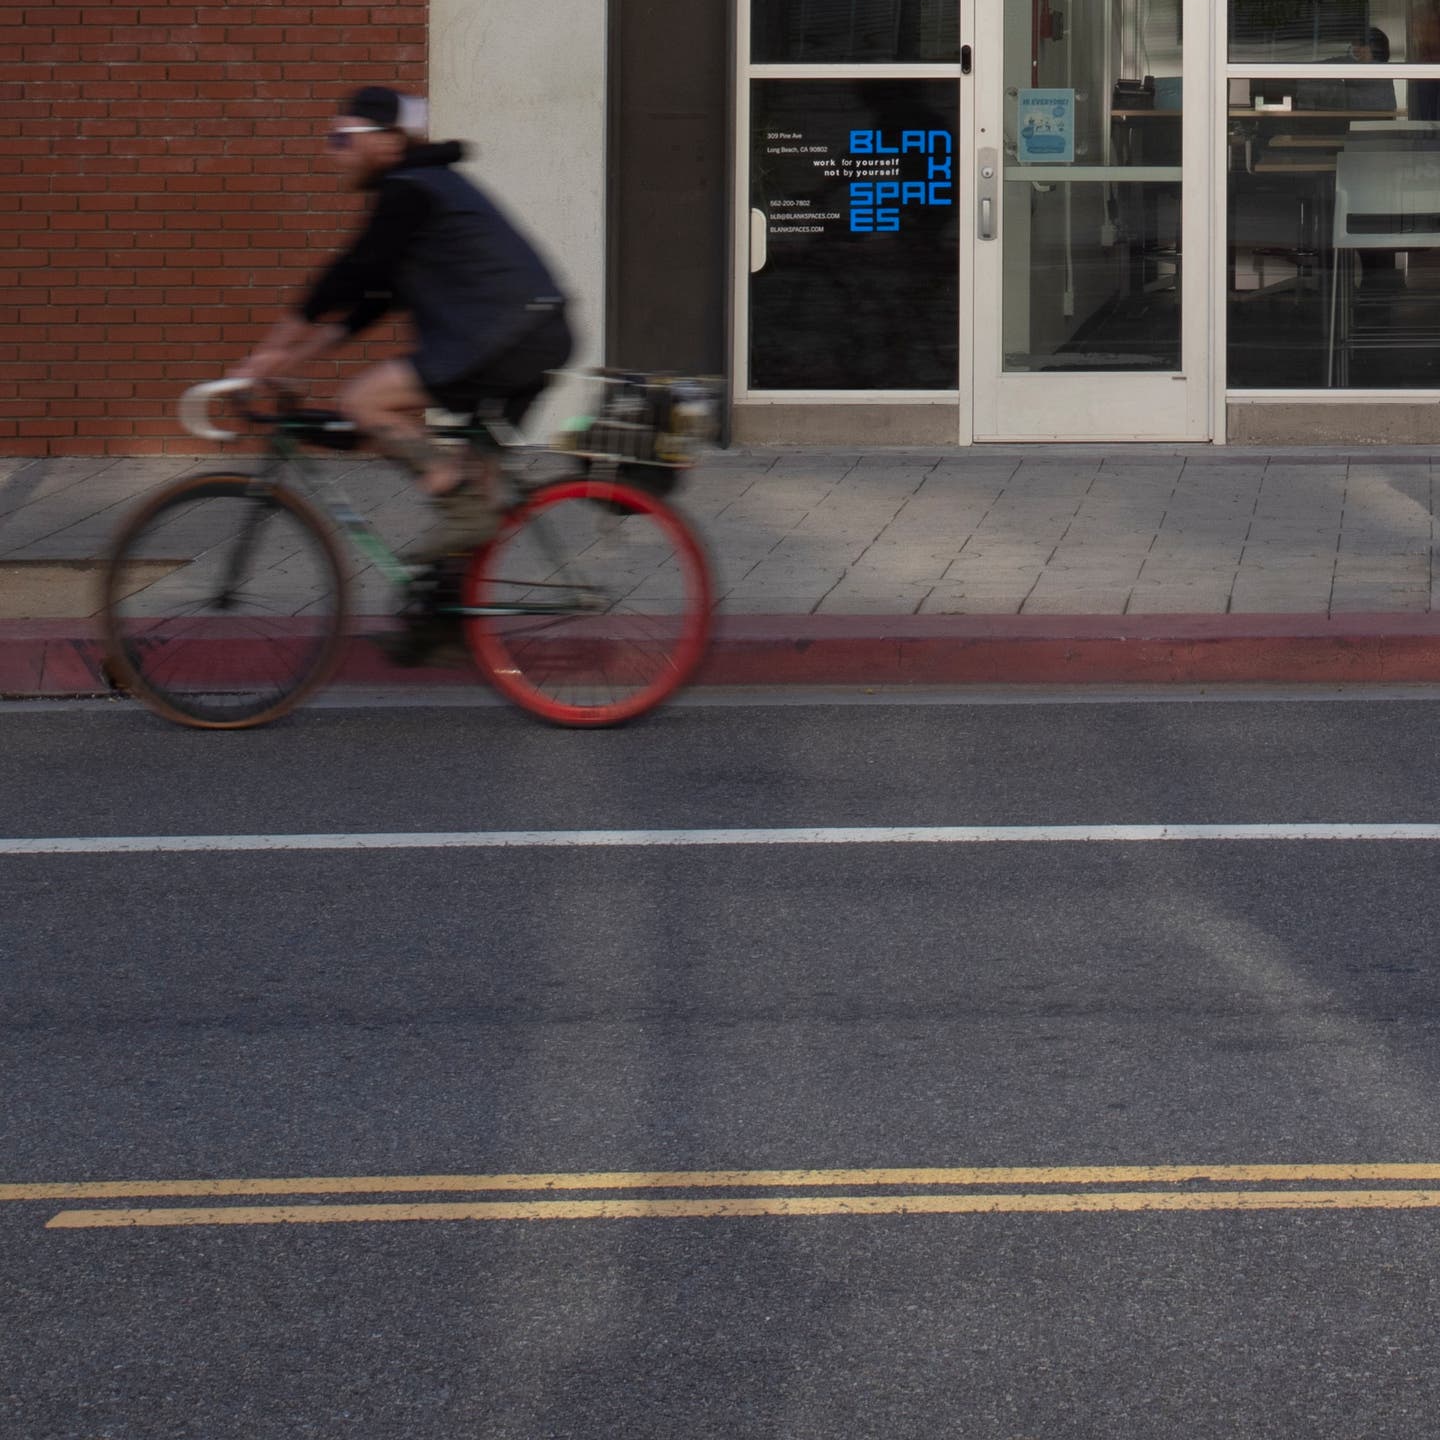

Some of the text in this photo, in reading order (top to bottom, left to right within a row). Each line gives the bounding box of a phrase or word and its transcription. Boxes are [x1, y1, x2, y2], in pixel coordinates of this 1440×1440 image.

[849, 130, 952, 154] BLAN
[812, 158, 900, 168] work for yourself
[823, 168, 900, 178] not by yourself
[927, 156, 952, 180] K
[850, 181, 952, 206] SPAC
[850, 208, 900, 232] ES
